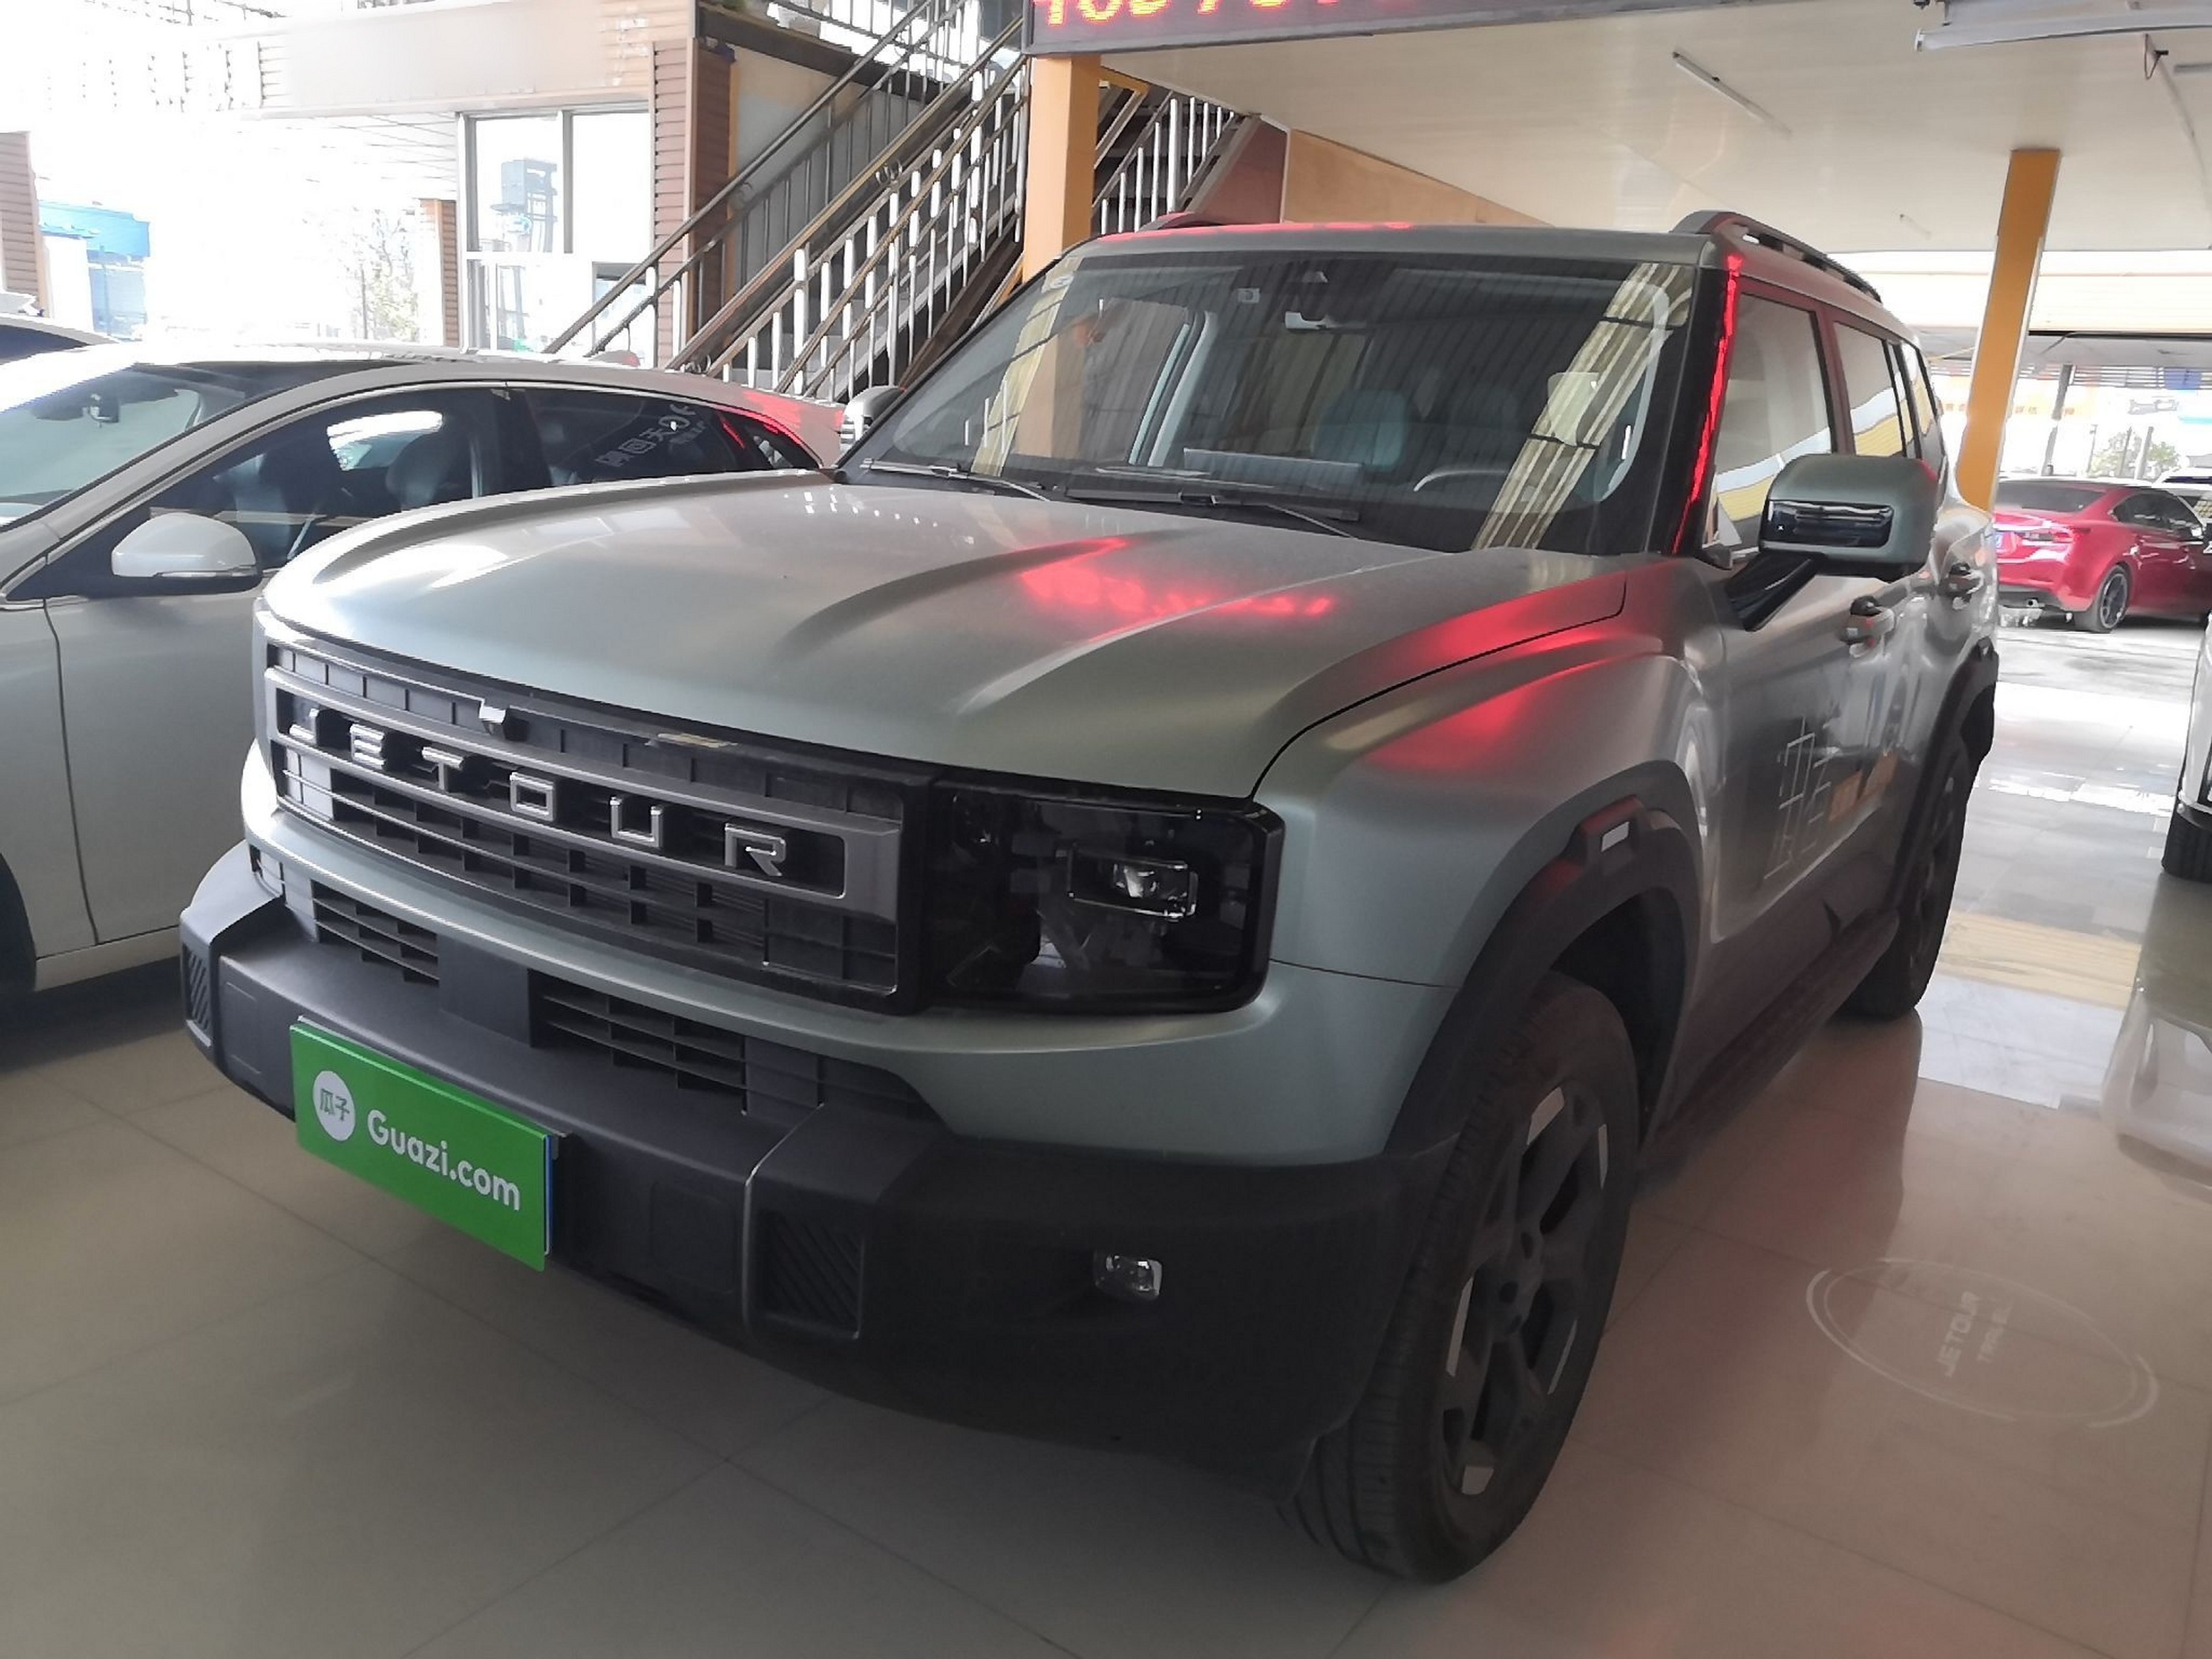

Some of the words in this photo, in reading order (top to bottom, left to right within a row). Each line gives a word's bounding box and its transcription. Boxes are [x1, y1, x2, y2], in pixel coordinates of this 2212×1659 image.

[287, 706, 787, 877] JETOUR
[319, 1088, 350, 1122] 瓜子
[367, 1109, 520, 1211] Guazi.com
